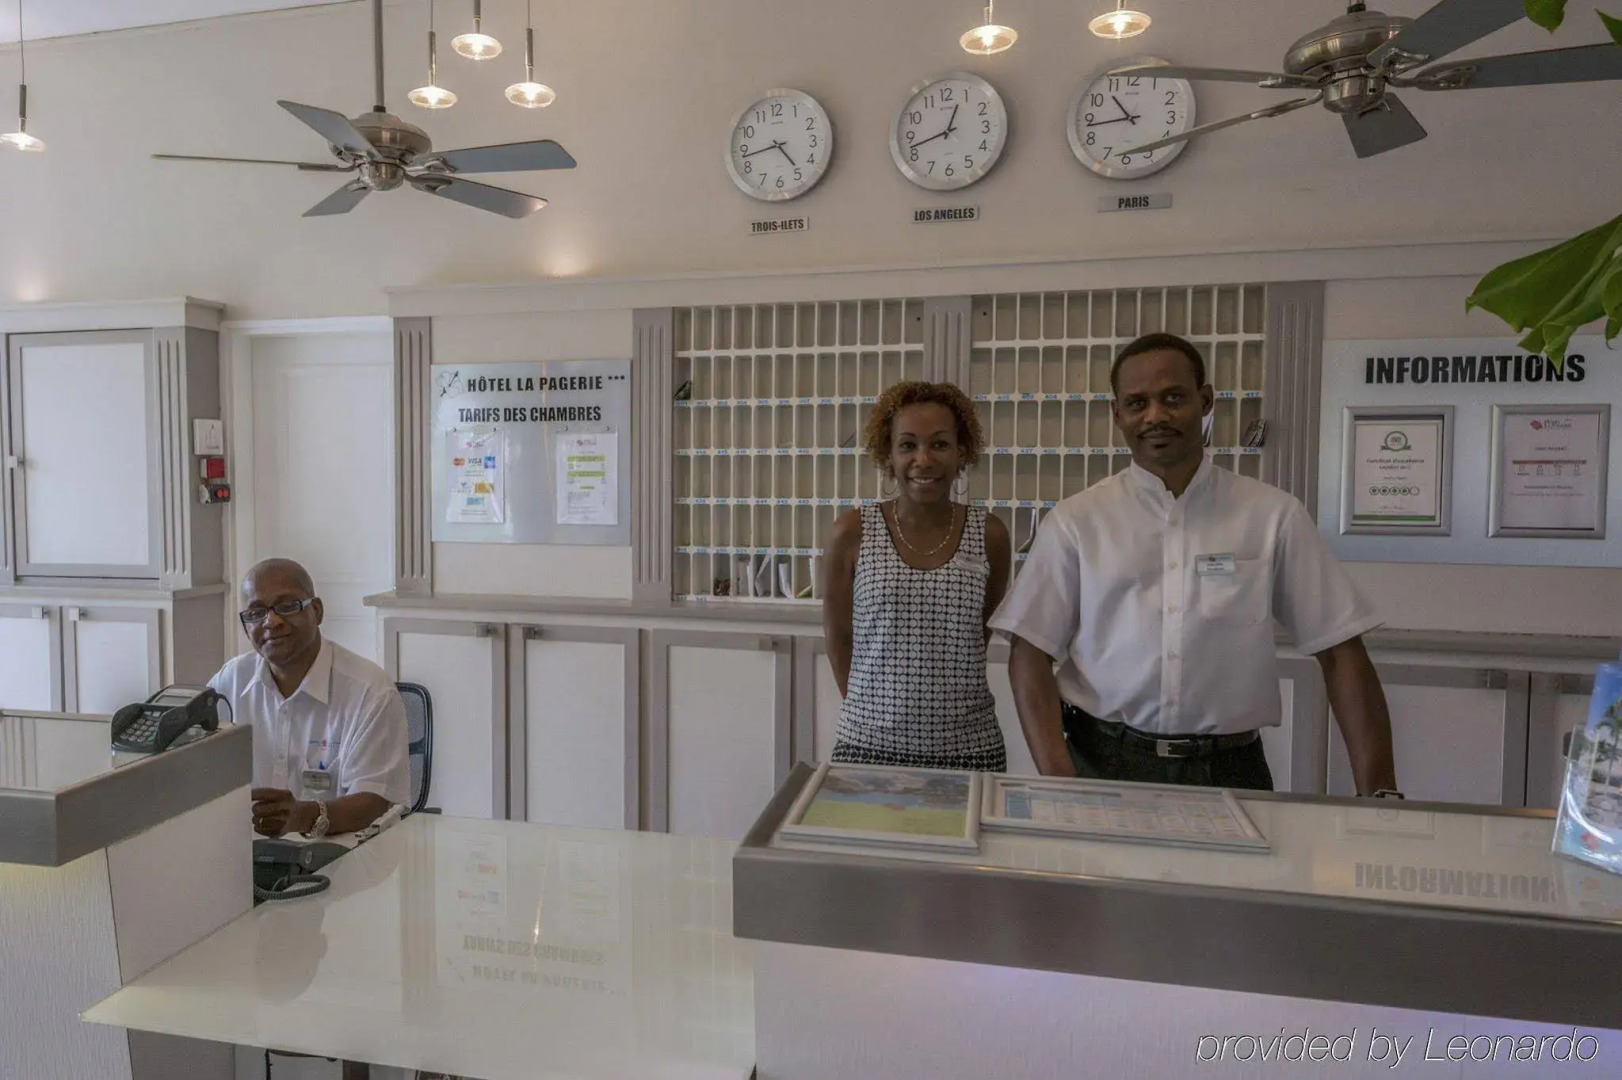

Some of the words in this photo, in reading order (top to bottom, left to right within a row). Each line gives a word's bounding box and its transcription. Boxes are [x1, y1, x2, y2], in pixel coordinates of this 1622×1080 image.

[940, 88, 952, 101] 12
[964, 90, 968, 102] 1
[1091, 93, 1103, 107] 10
[1165, 91, 1174, 105] 2
[924, 96, 934, 108] 11
[770, 104, 783, 116] 12
[792, 105, 797, 117] 1
[978, 102, 987, 115] 2
[756, 111, 765, 123] 11
[910, 111, 921, 125] 10
[1166, 111, 1175, 124] 3
[805, 118, 814, 130] 2
[982, 120, 990, 133] 3
[743, 126, 754, 138] 10
[906, 131, 914, 143] 9
[809, 135, 817, 148] 3
[1087, 132, 1095, 145] 8
[979, 140, 987, 151] 4
[807, 153, 815, 164] 4
[911, 148, 918, 161] 8
[1104, 147, 1112, 160] 7
[744, 161, 752, 173] 8
[927, 161, 935, 174] 7
[964, 156, 973, 168] 5
[793, 168, 802, 180] 5
[945, 164, 954, 176] 6
[759, 173, 767, 185] 7
[776, 176, 784, 188] 6
[1118, 196, 1149, 208] PARIS
[914, 210, 932, 221] LOS
[934, 208, 975, 220] ANGELES
[1365, 355, 1585, 383] INFORMATIONS
[468, 377, 512, 392] HÔTEL
[518, 378, 534, 391] LA
[540, 376, 603, 390] PAGERIE
[458, 408, 500, 422] TARIFS
[504, 408, 527, 422] DES
[530, 406, 601, 422] CHAMBRES
